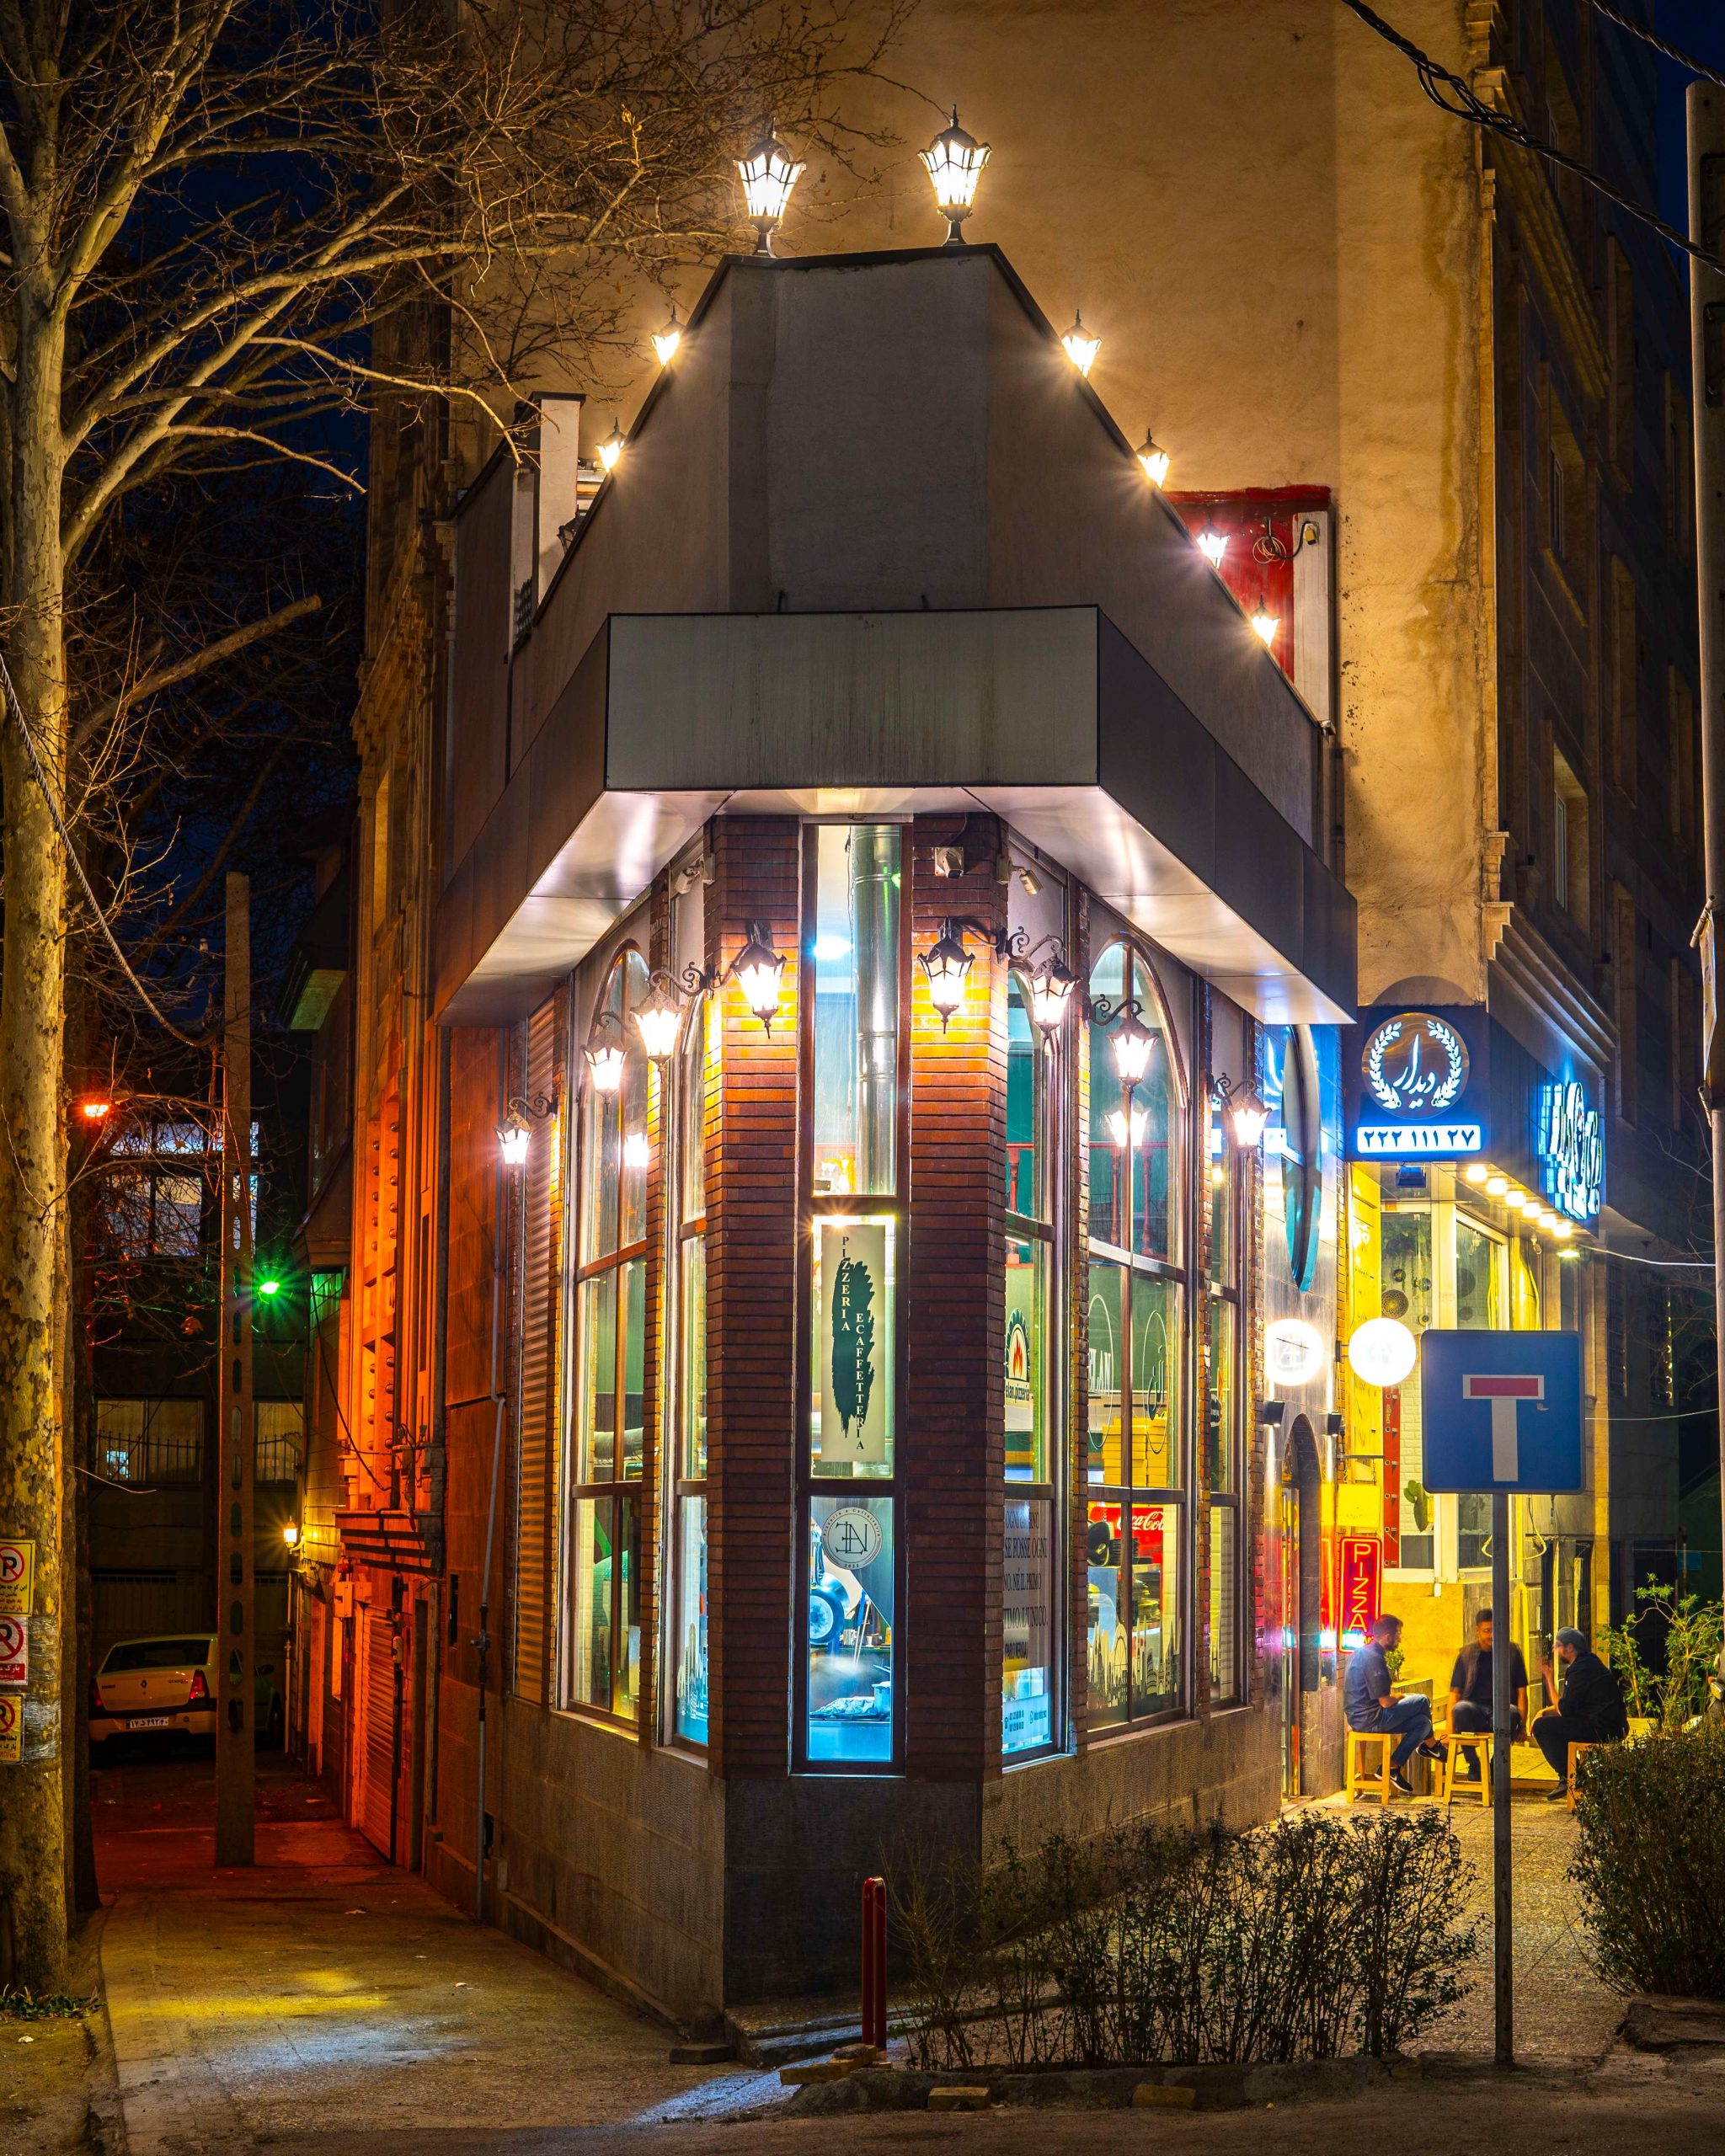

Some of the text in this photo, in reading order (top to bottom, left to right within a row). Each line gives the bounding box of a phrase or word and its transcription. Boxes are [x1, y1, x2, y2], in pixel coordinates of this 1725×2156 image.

[1393, 1034, 1435, 1109] دیدار
[1363, 1129, 1475, 1148] ۲۲۲ ۱۱۱ ۲۷
[841, 1236, 851, 1331] PIZZERIA
[1004, 1538, 1047, 1558] SE FOSSE OGNI
[1348, 1543, 1371, 1633] PIZZA
[4, 1664, 20, 1673] پارک
